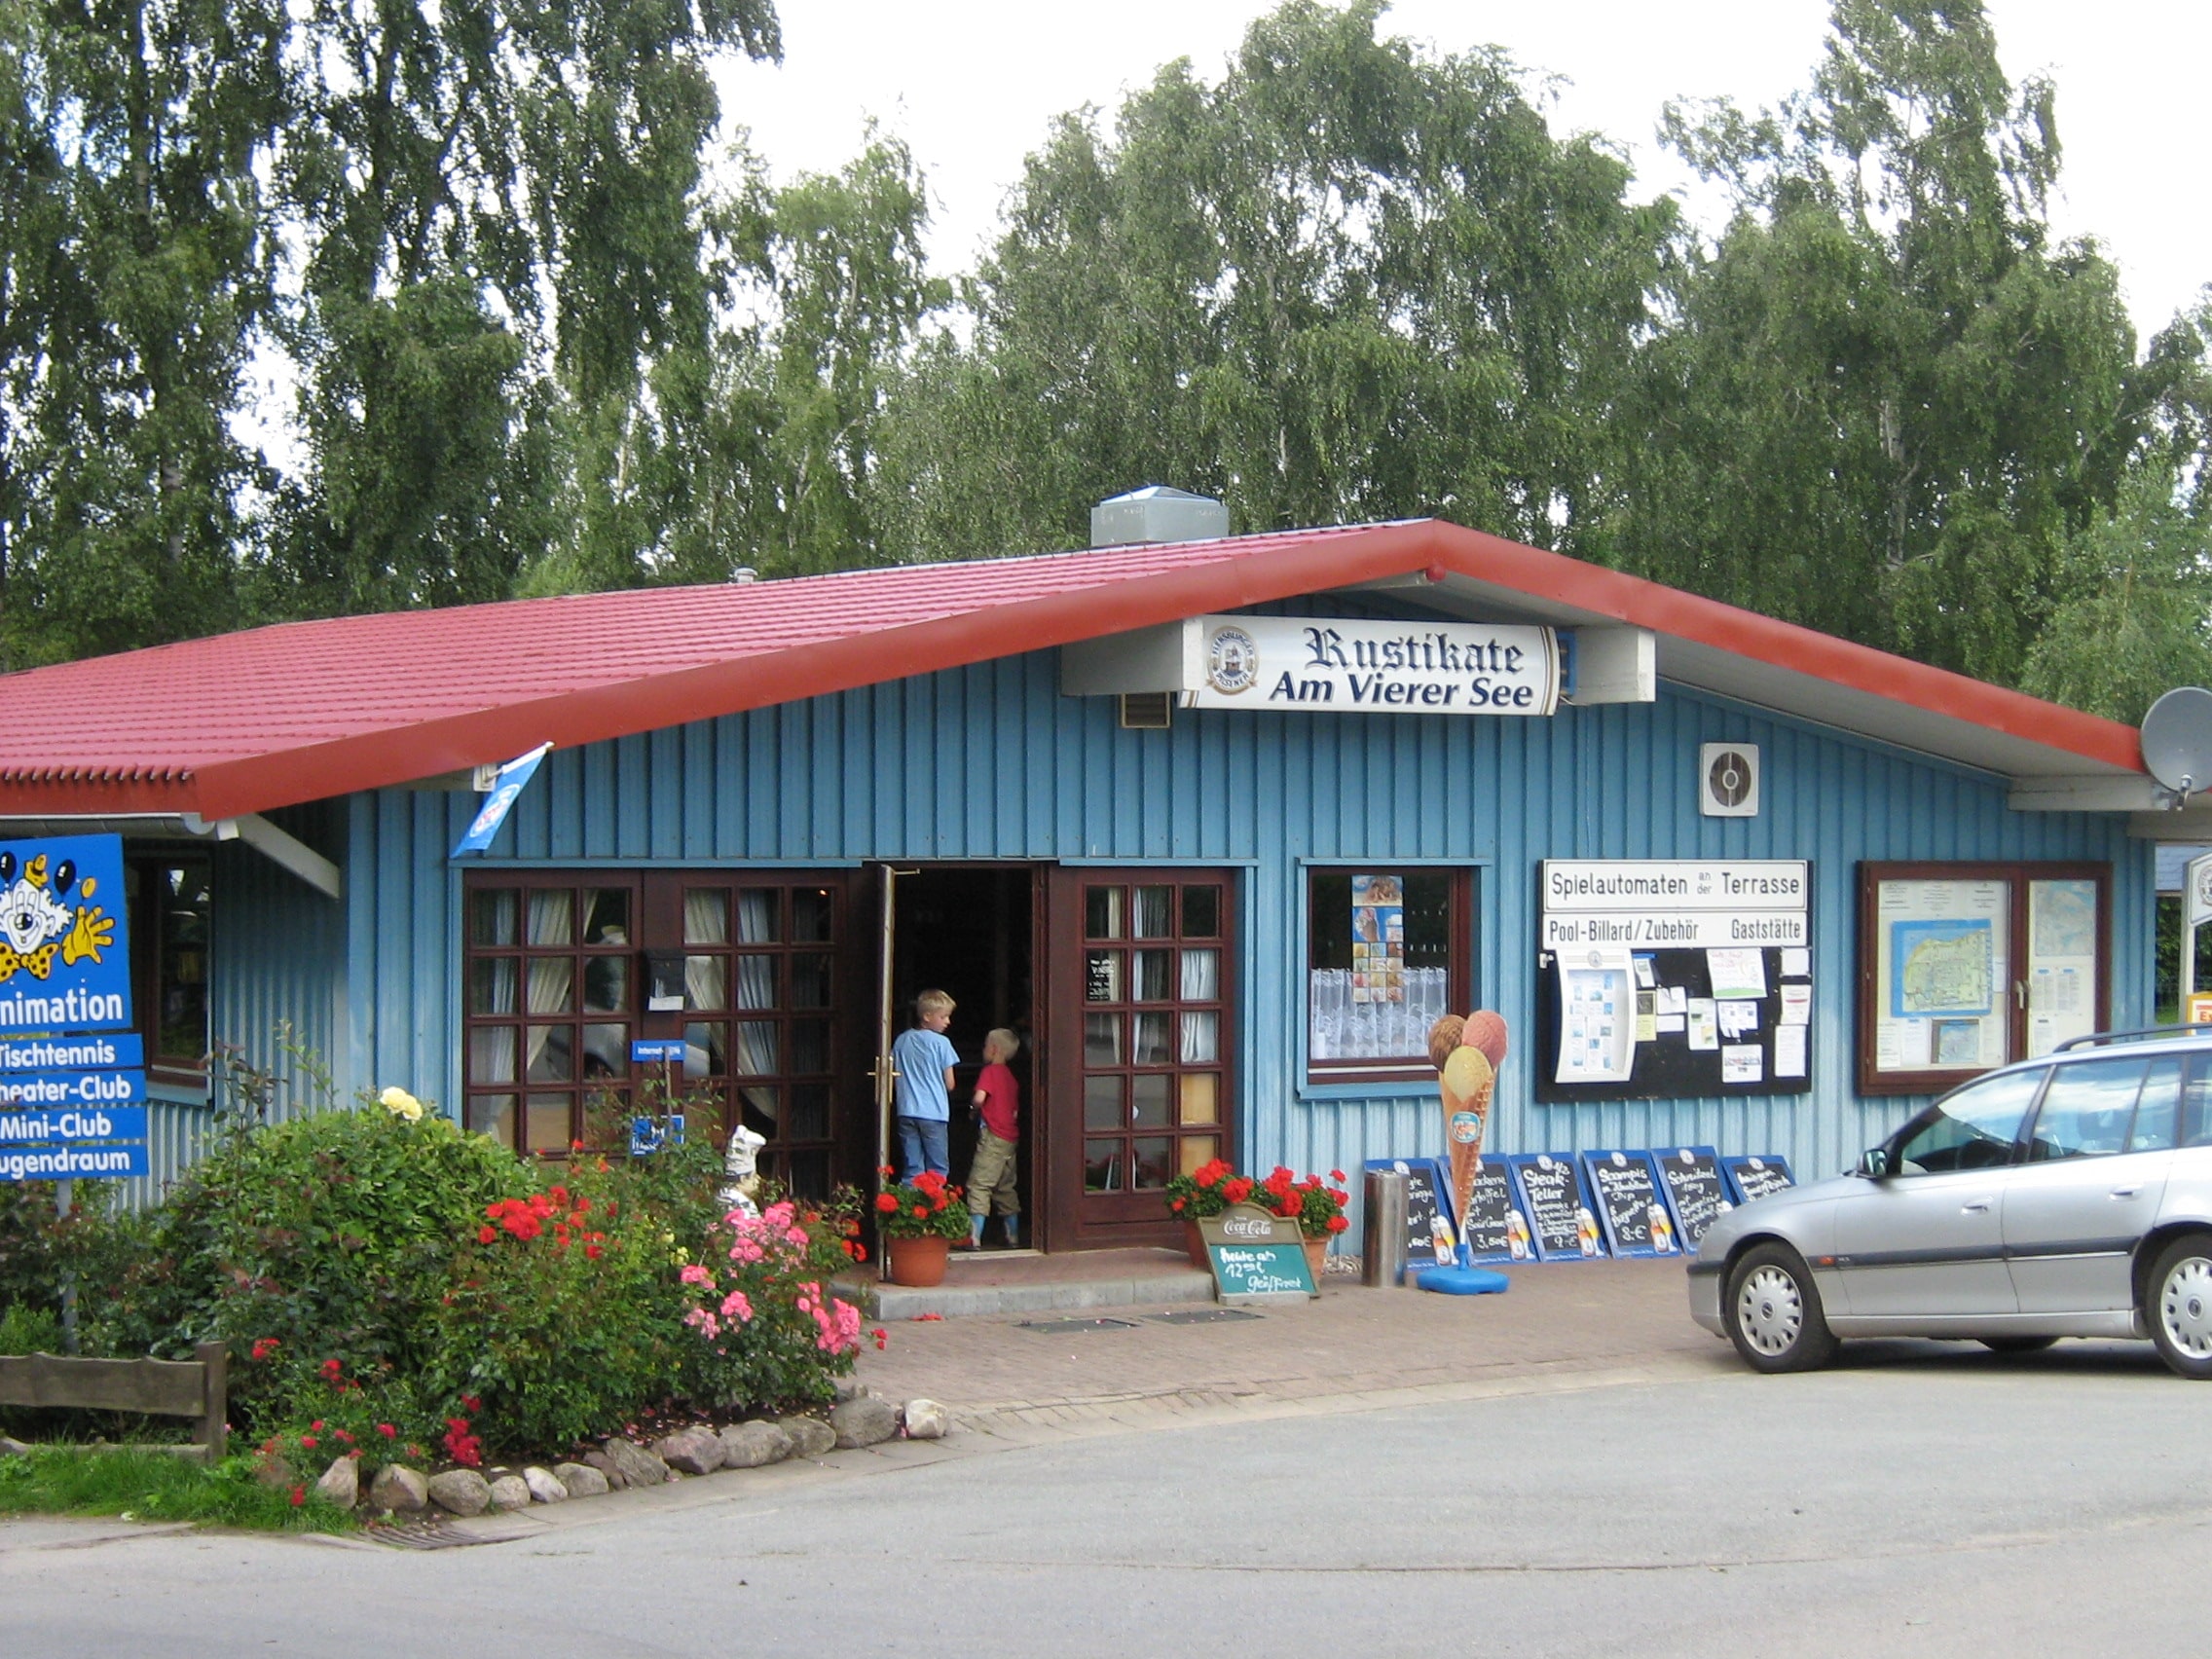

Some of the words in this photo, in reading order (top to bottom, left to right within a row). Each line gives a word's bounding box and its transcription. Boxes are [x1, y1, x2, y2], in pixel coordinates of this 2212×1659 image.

[1305, 625, 1525, 674] Rustikate
[1269, 670, 1333, 703] Am
[1350, 672, 1459, 705] Vierer
[1469, 676, 1533, 708] See
[1552, 872, 1688, 901] Spielautomaten
[1697, 883, 1713, 895] der
[1699, 872, 1712, 881] an
[1721, 871, 1800, 895] Terrasse
[1731, 918, 1801, 940] Gaststätte
[0, 987, 124, 1025] nimation
[0, 1074, 131, 1102] eater-Club
[0, 1111, 113, 1140] Mini-Club
[0, 1147, 130, 1180] ugendraum
